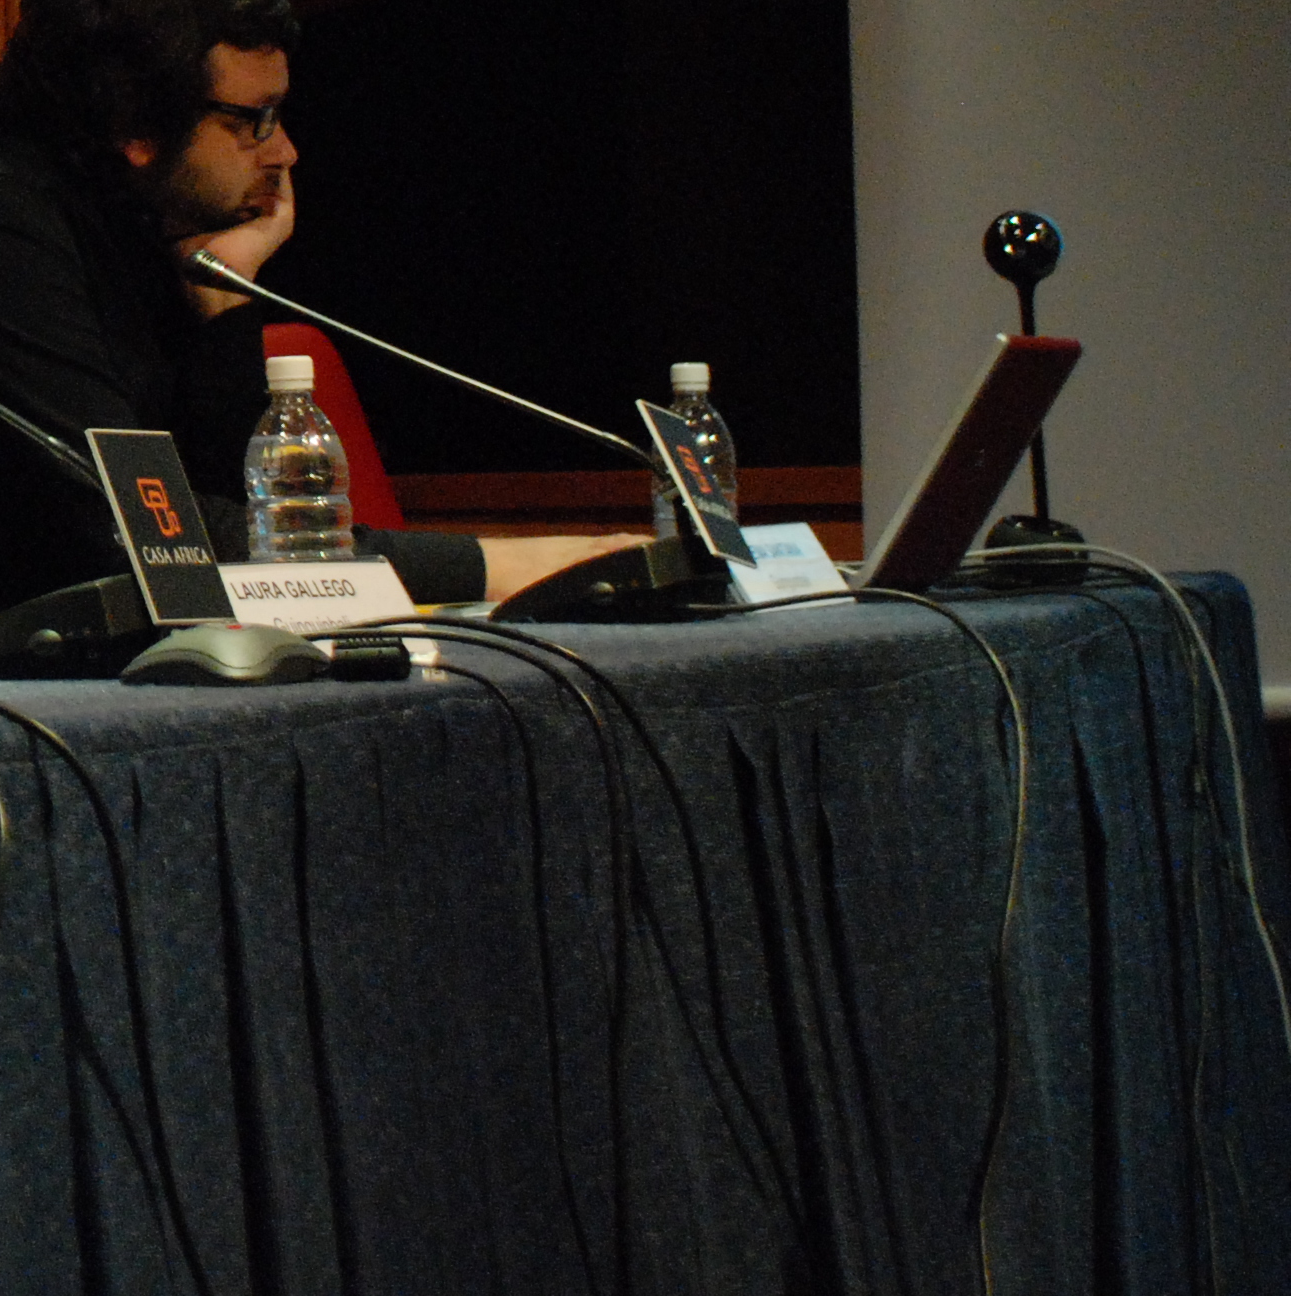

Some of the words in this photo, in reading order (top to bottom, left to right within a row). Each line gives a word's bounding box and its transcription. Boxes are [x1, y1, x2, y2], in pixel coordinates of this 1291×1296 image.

[142, 546, 172, 565] CASA
[173, 546, 212, 565] AFRICA
[229, 580, 287, 601] LAURA
[284, 578, 357, 598] GALLEGO
